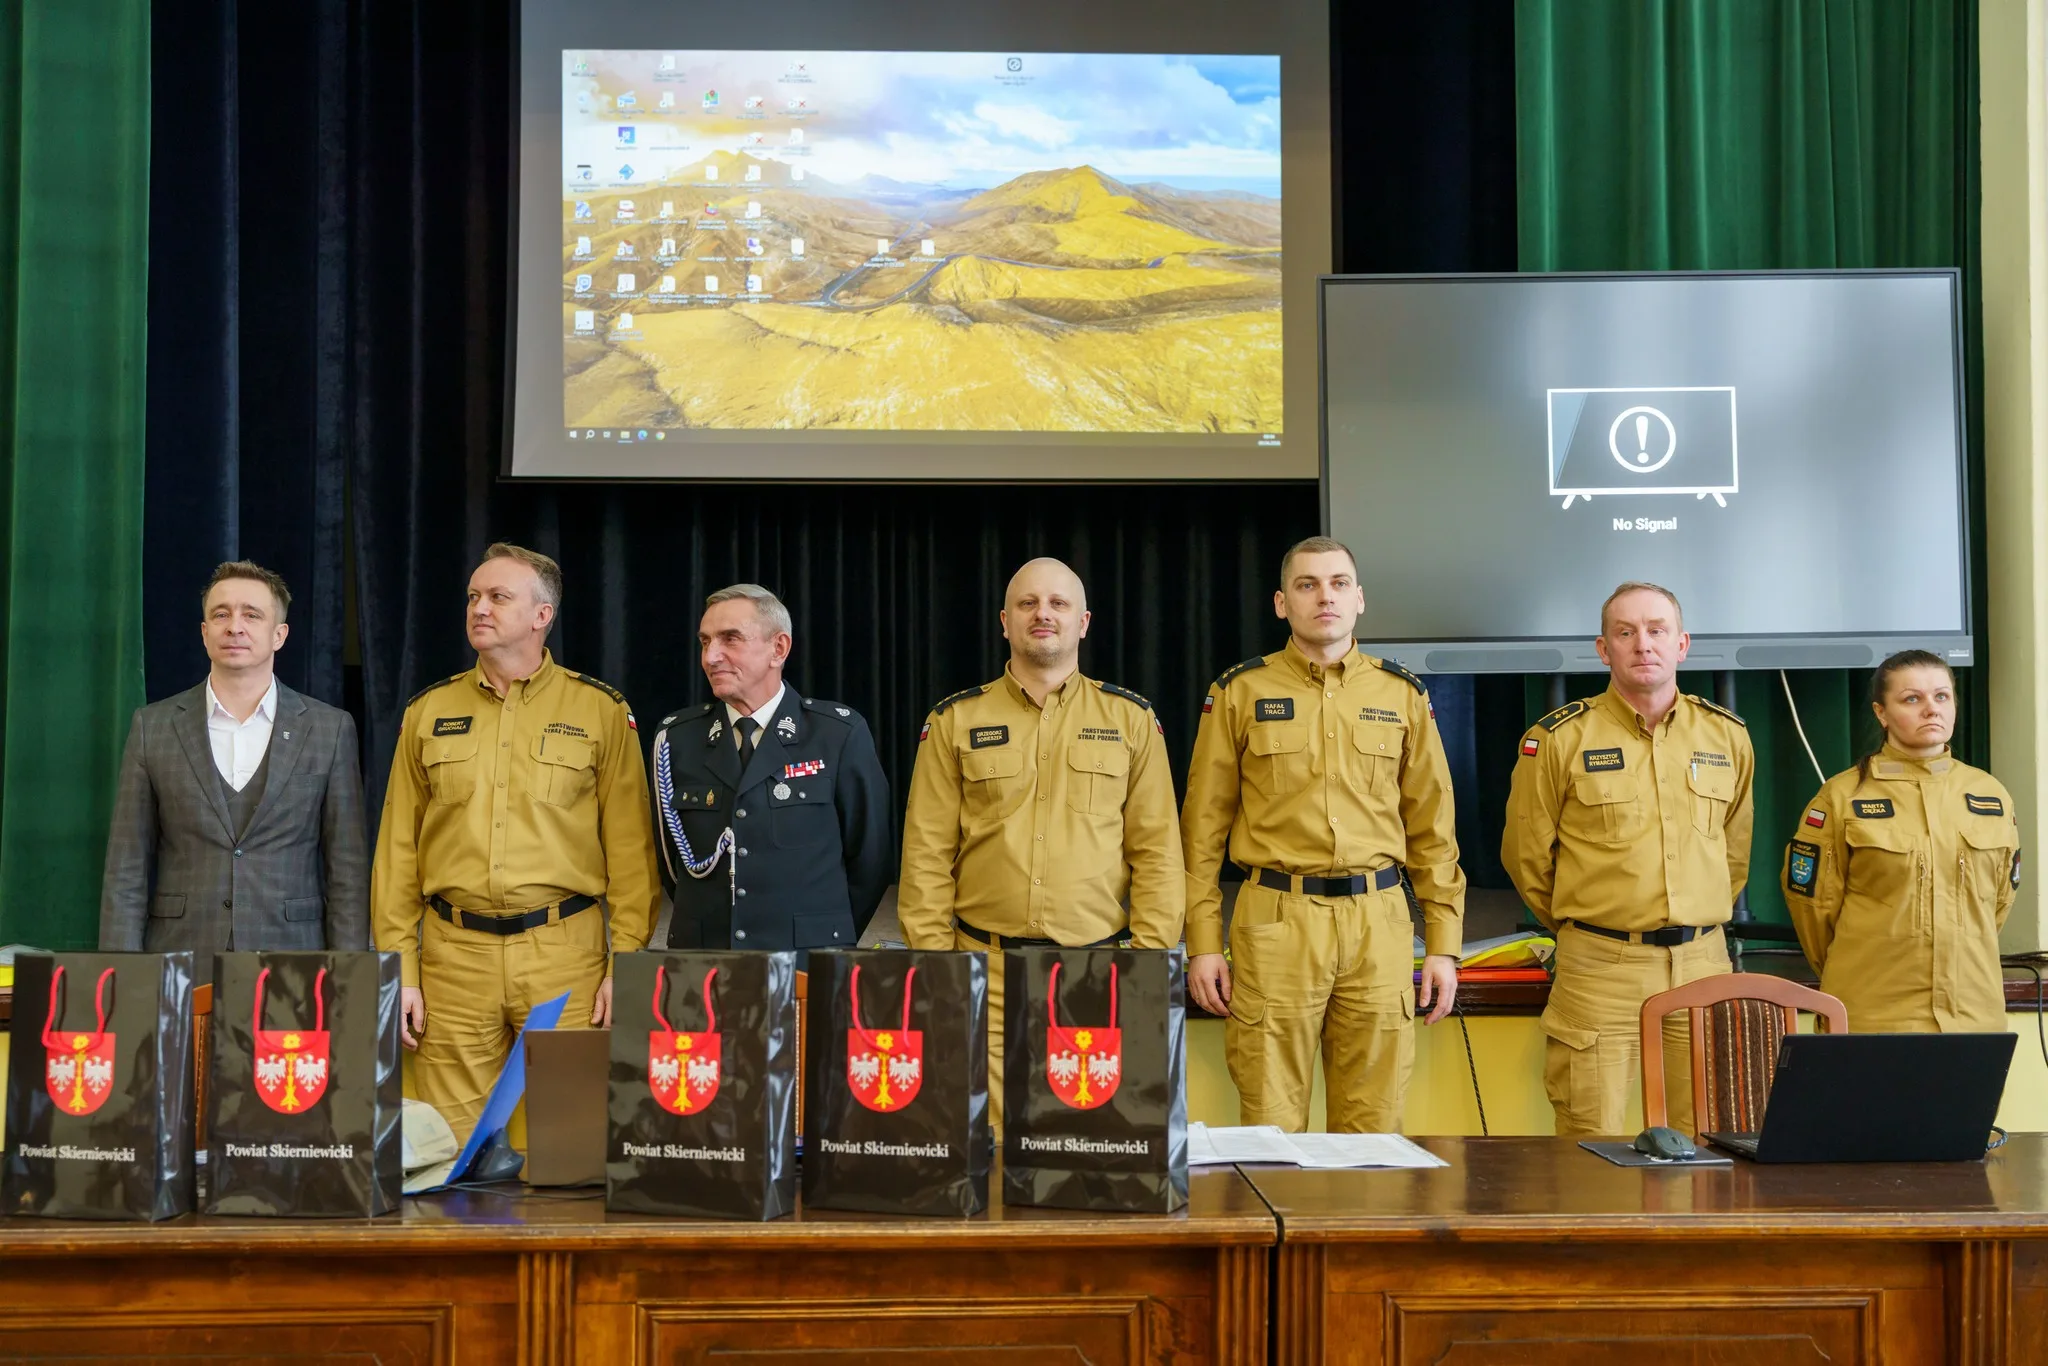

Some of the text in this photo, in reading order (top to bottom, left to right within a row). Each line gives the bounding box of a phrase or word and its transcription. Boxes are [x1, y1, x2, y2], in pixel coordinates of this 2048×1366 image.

[1612, 516, 1678, 534] No Signal
[19, 1143, 136, 1162] Powiat Skierniewicki
[225, 1143, 354, 1159] Powiat Skierniewicki
[622, 1142, 746, 1162] Powiat Skierniewicki
[820, 1138, 950, 1158] Powiat Skierniewicki
[1020, 1136, 1150, 1154] Powiat Skierniewicki
